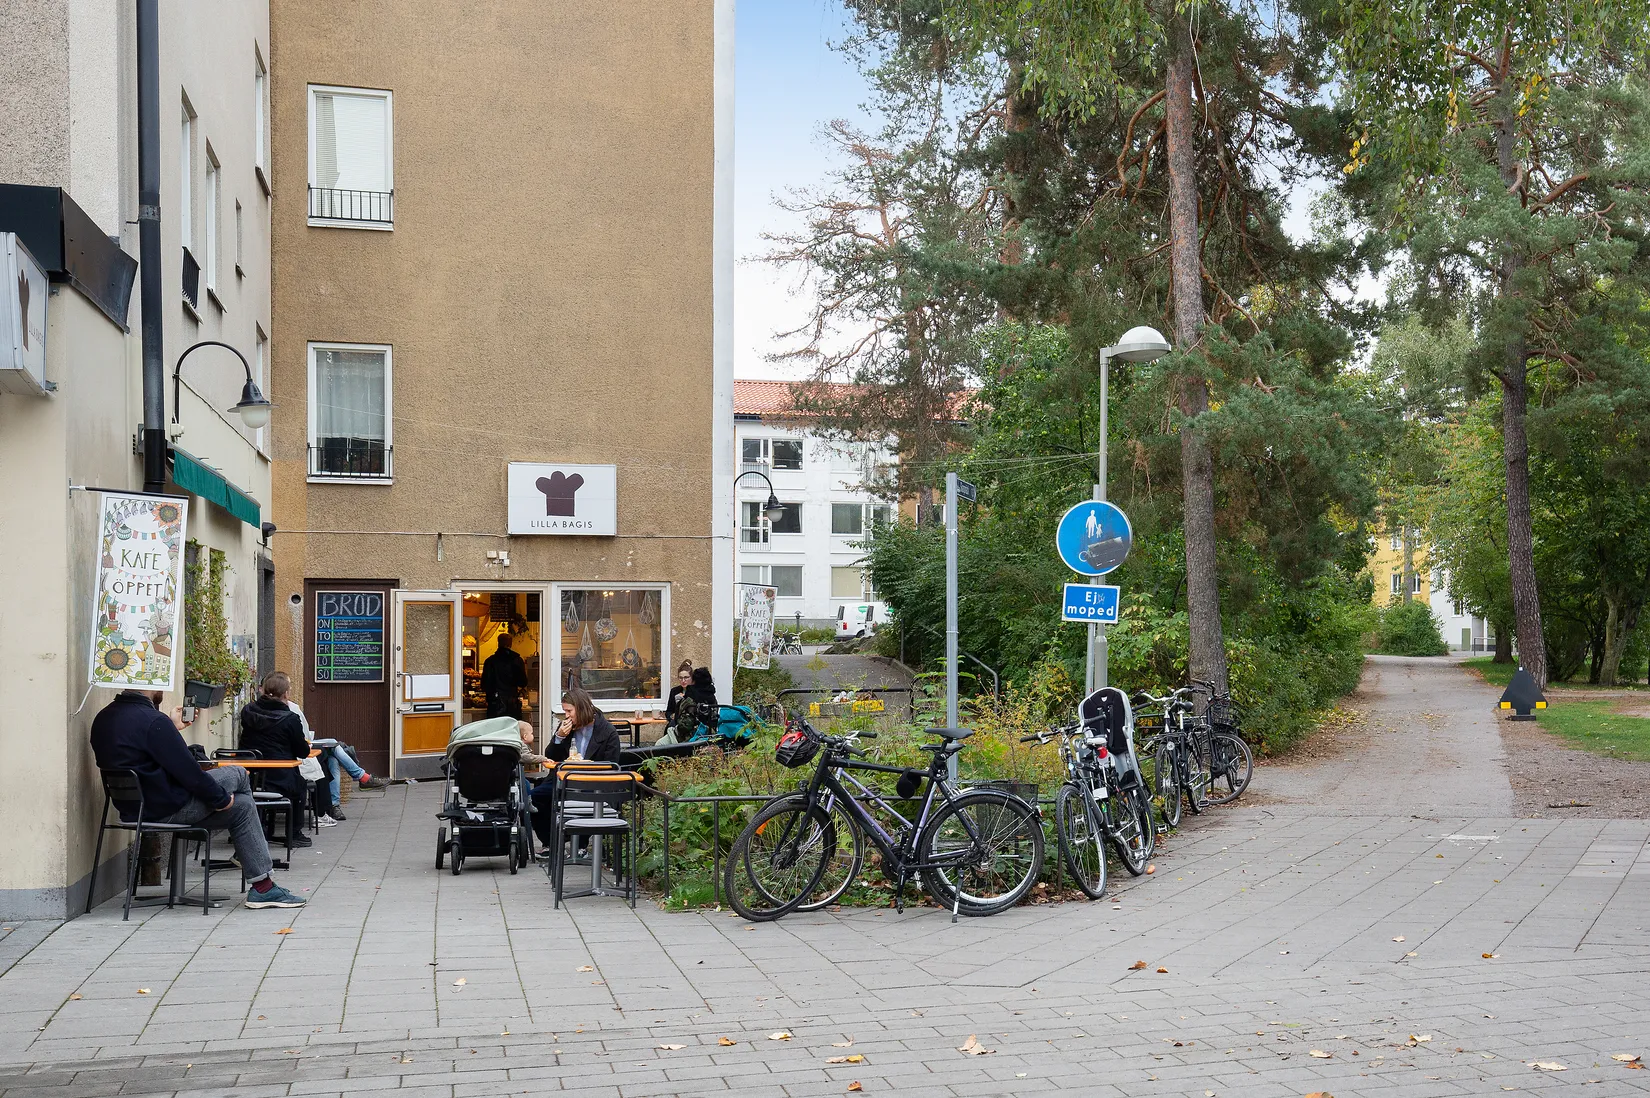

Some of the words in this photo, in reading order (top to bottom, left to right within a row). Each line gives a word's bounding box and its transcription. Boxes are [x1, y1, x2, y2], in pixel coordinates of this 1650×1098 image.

[530, 520, 558, 528] LILLA
[562, 520, 593, 529] BAGIS
[121, 548, 161, 570] KAFÉ
[112, 578, 163, 597] ÖPPET
[1085, 591, 1097, 605] Ej
[1067, 605, 1114, 617] moped
[318, 619, 331, 629] ON
[318, 632, 331, 641] TO
[318, 644, 330, 654] FR
